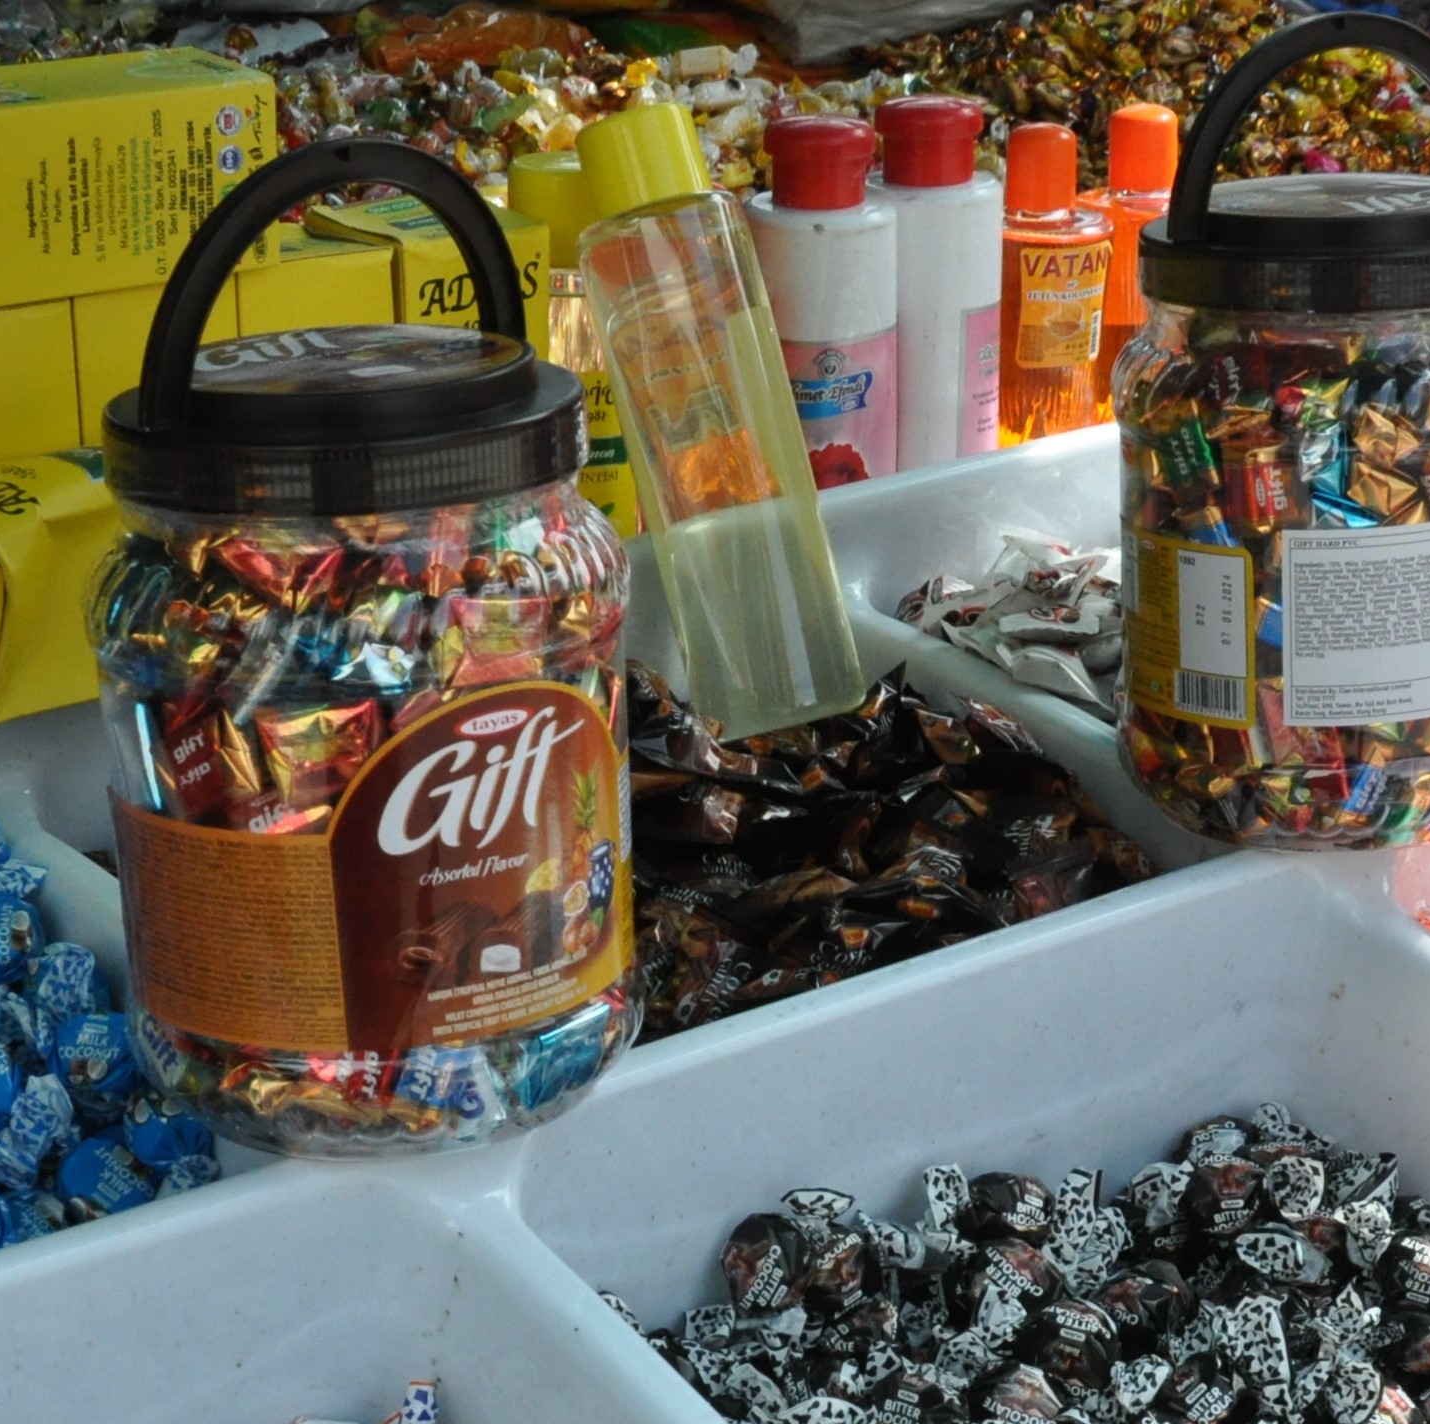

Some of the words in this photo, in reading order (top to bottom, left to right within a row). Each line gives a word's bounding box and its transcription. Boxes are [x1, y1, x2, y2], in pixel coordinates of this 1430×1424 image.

[152, 110, 161, 137] 2025
[156, 221, 165, 246] 2020
[1022, 252, 1109, 277] VATAN
[826, 375, 867, 404] Efendi
[377, 705, 585, 855] Gift
[419, 866, 480, 886] Assorted
[58, 1044, 121, 1059] COCONUT
[76, 1033, 109, 1047] MILK
[769, 1266, 786, 1308] BITTER
[883, 1399, 922, 1421] BITTER
